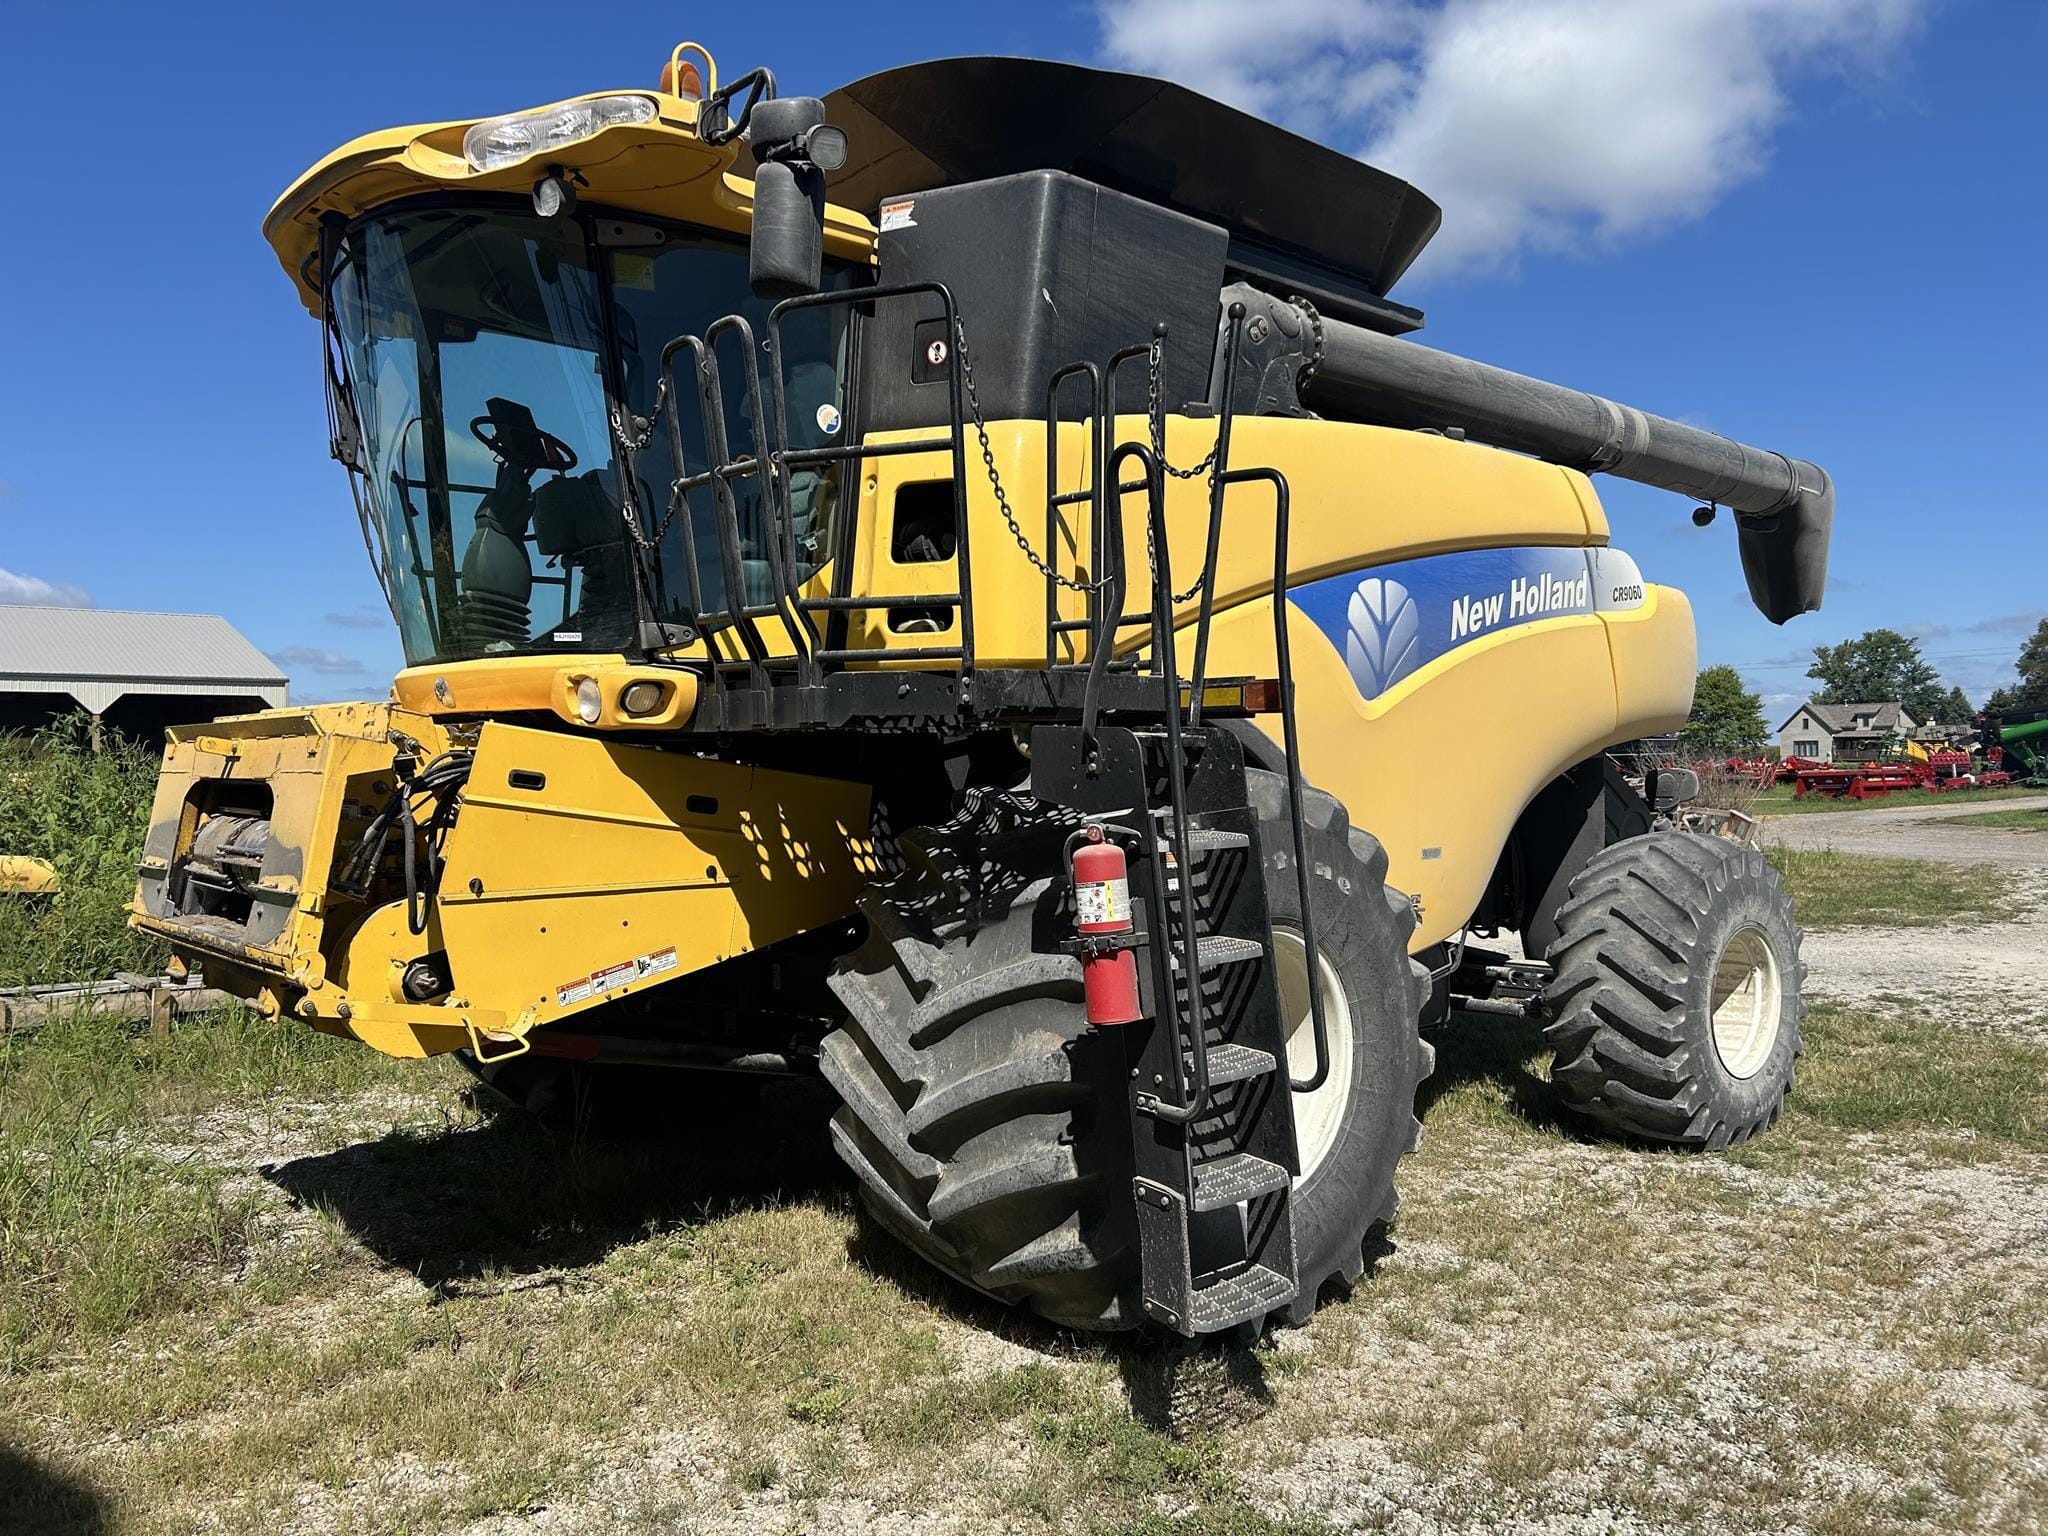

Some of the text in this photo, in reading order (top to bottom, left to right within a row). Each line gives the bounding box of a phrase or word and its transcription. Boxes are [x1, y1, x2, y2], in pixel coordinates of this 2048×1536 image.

[1450, 569, 1588, 642] New Holland
[1612, 584, 1643, 603] CR9060
